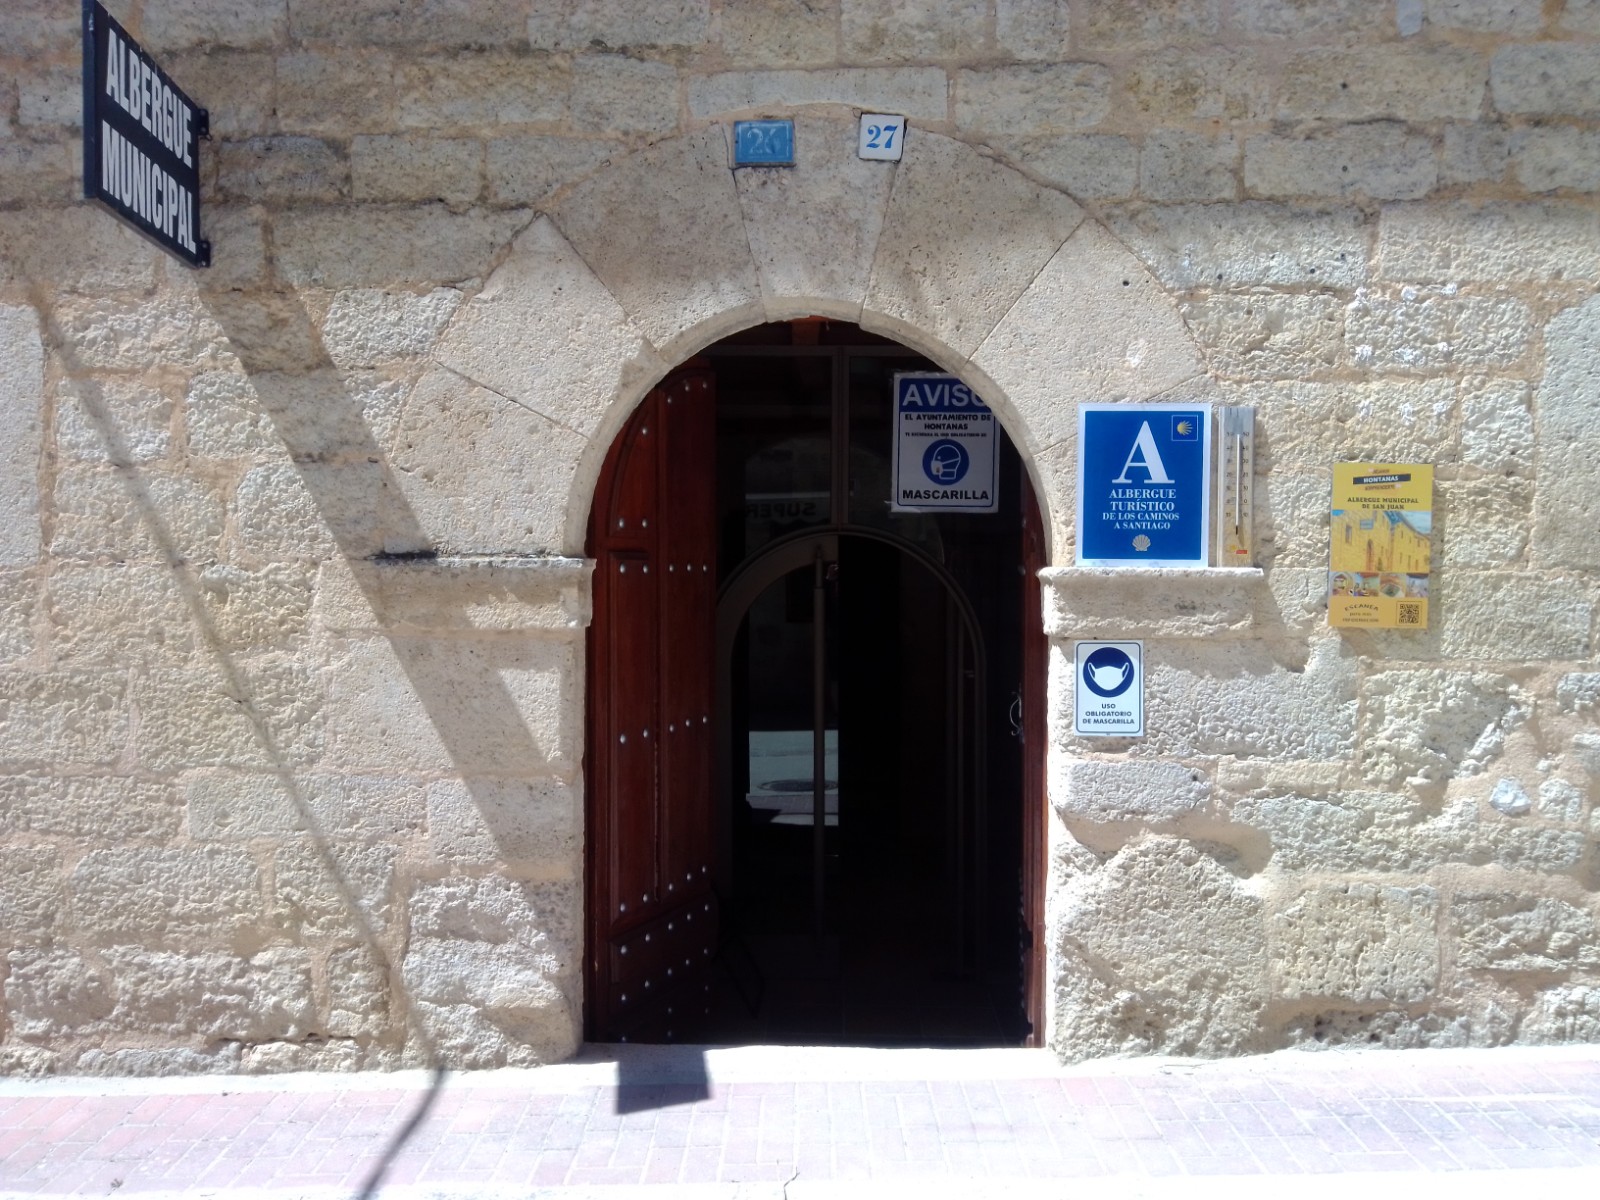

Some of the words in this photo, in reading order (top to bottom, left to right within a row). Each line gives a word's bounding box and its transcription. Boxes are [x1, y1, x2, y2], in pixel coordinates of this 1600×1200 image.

[106, 28, 192, 169] ALBERGUE
[866, 125, 898, 149] 27
[102, 119, 196, 255] MUNICIPAL
[1112, 420, 1175, 484] A
[902, 490, 989, 500] MASCARILLA
[1109, 489, 1176, 499] ALBERGUE
[1110, 499, 1174, 511] TURÍSTICO
[1123, 522, 1170, 530] SANTIAGO
